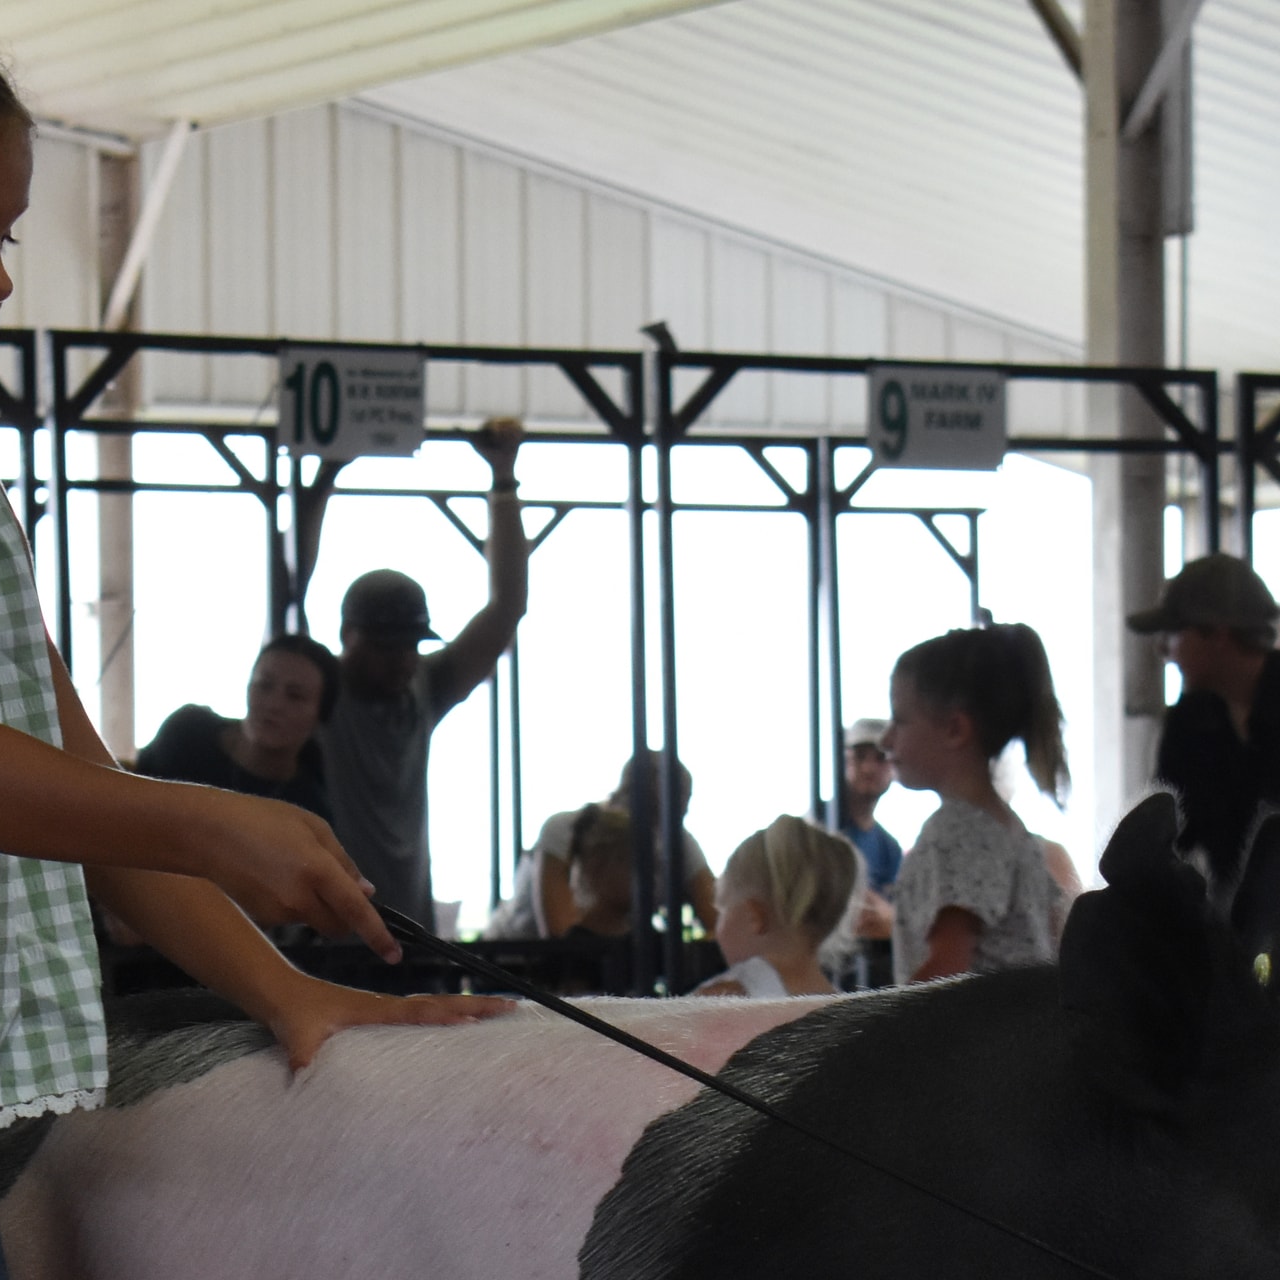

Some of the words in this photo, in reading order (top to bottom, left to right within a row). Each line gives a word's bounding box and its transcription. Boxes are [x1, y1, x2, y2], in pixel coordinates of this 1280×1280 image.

[285, 361, 340, 446] 10
[880, 379, 907, 461] 9
[925, 410, 983, 430] FARM
